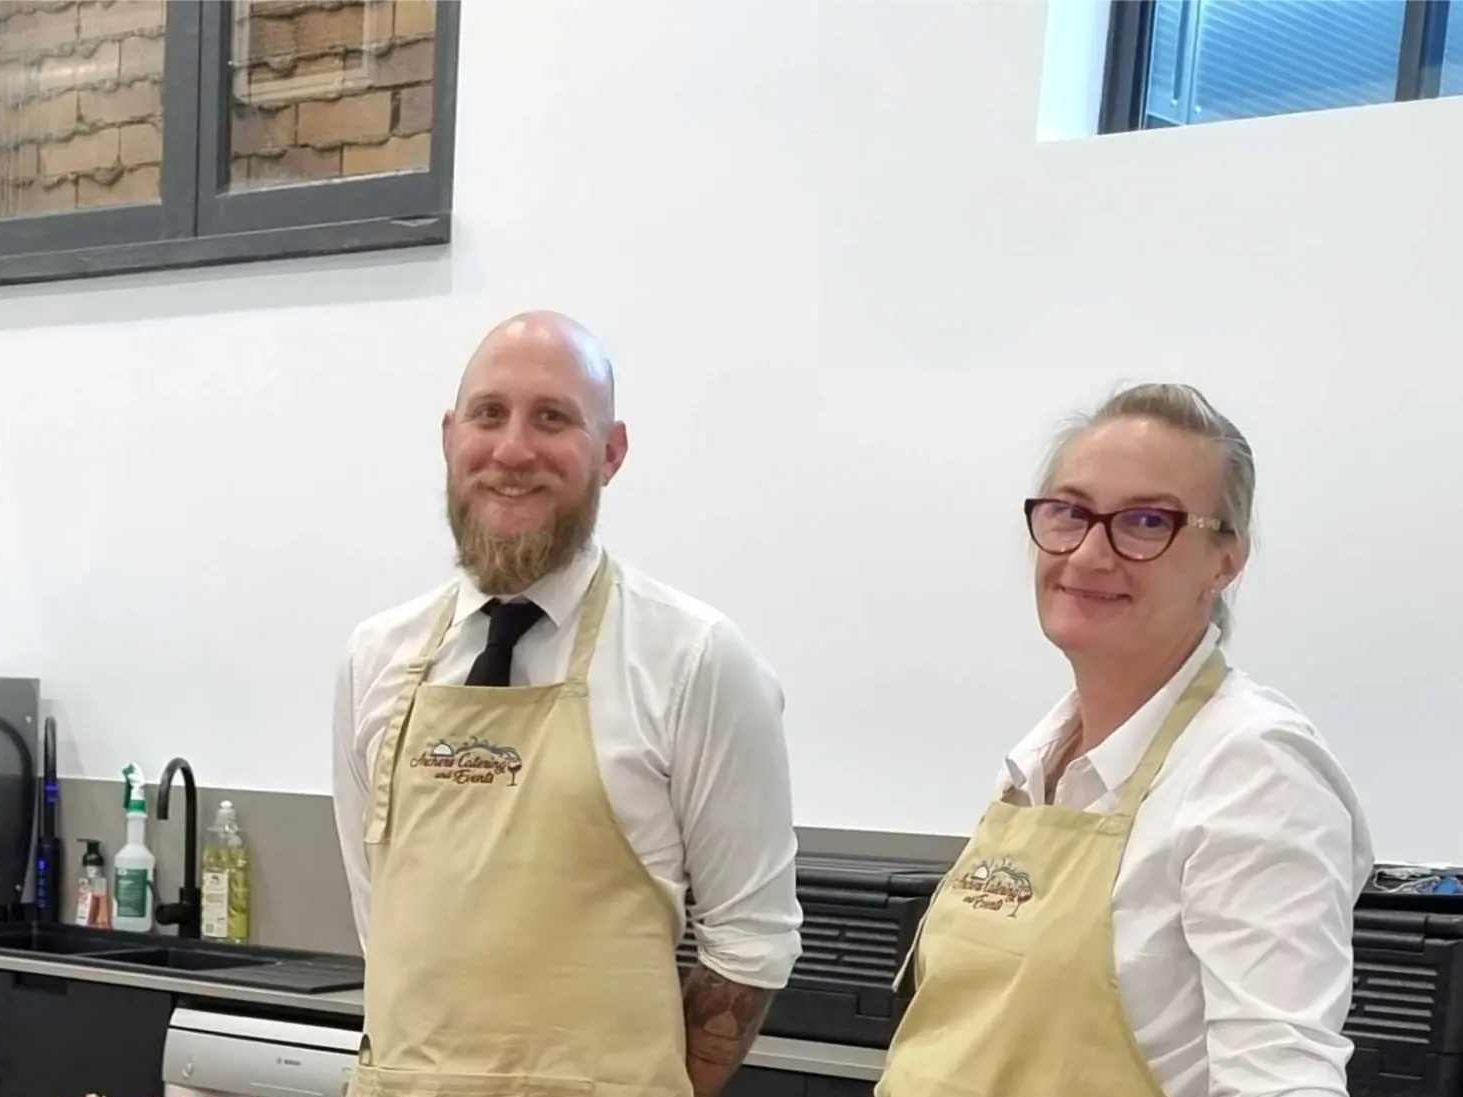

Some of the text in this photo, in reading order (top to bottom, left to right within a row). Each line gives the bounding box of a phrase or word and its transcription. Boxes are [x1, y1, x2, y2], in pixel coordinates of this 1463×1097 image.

[458, 752, 507, 775] Catering
[434, 769, 495, 785] and Events
